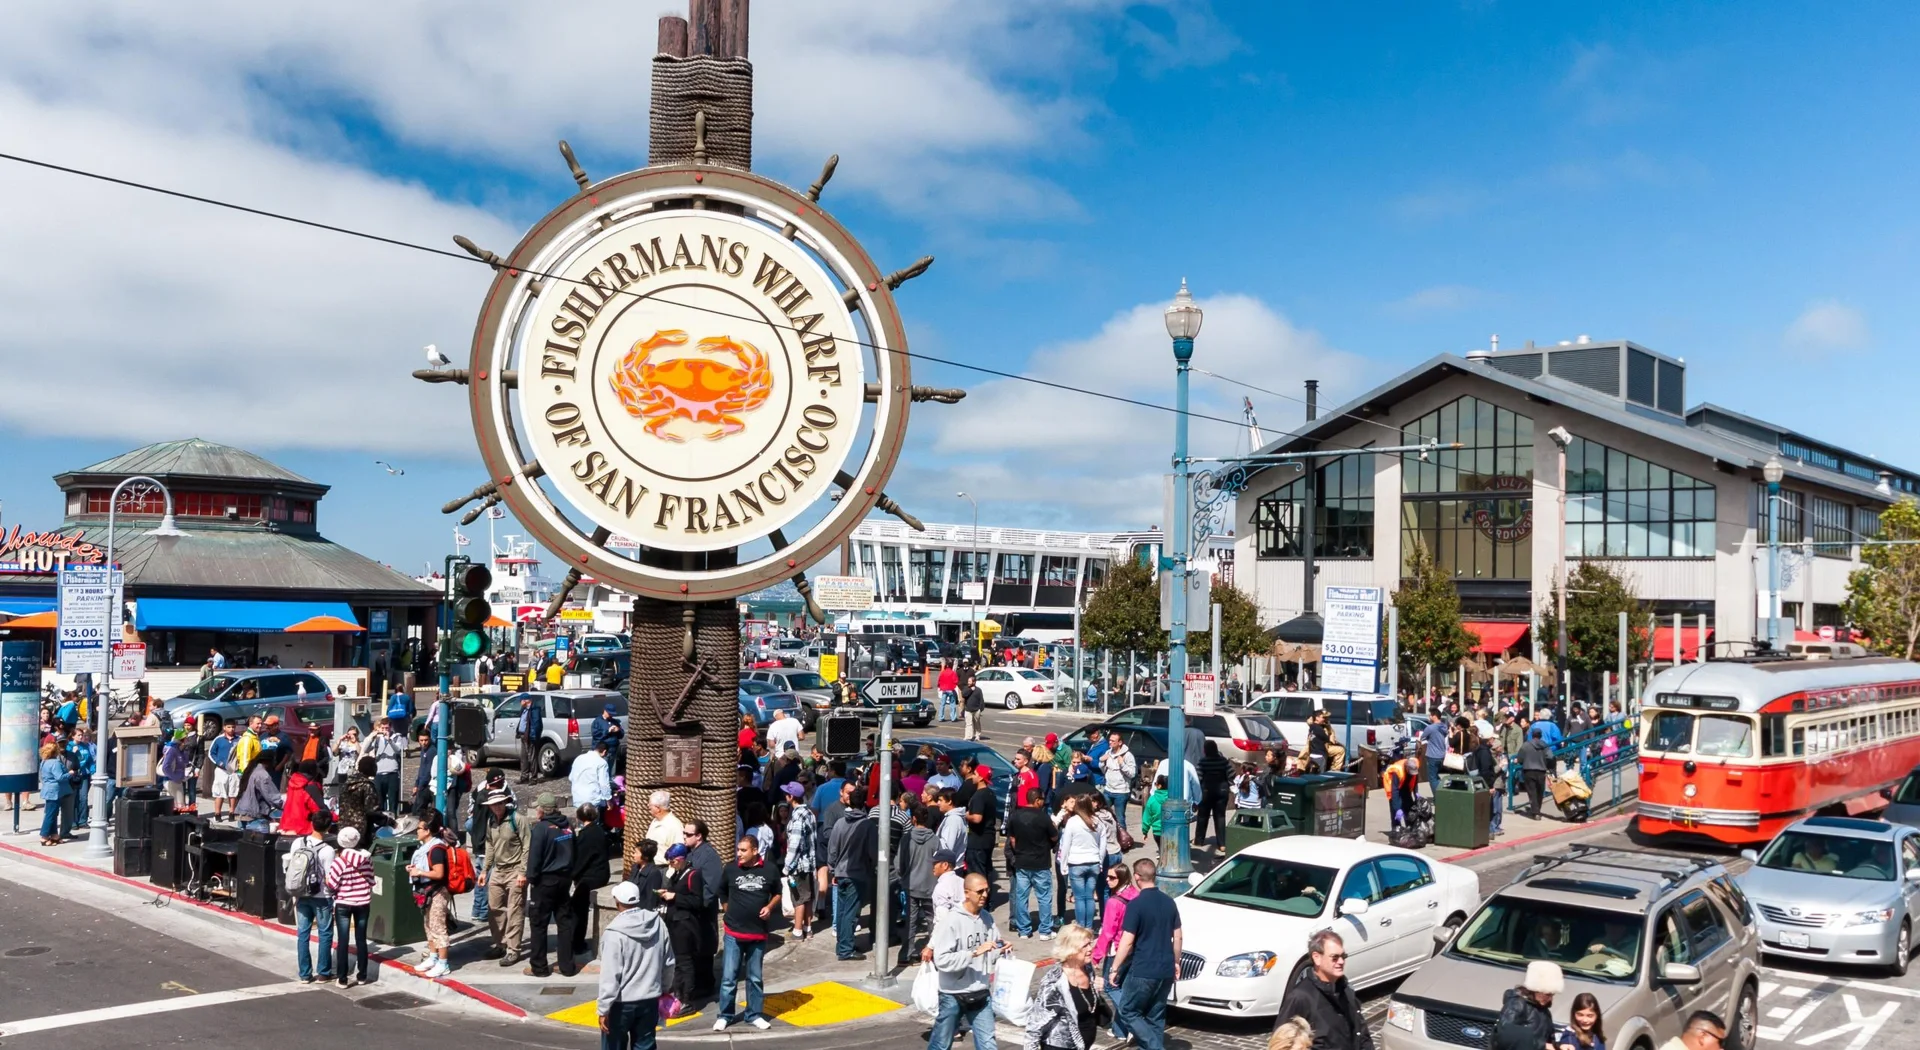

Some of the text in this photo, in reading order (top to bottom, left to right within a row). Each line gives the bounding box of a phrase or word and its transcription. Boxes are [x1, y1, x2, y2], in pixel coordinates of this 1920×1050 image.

[541, 233, 841, 386] FISHERMANS WHARF
[545, 402, 838, 533] OF SAN FRANCISCO
[0, 524, 103, 563] howder
[20, 550, 70, 571] HUT
[64, 628, 98, 638] $3.00
[1326, 644, 1354, 654] $3.00
[881, 685, 916, 696] ONE WAY
